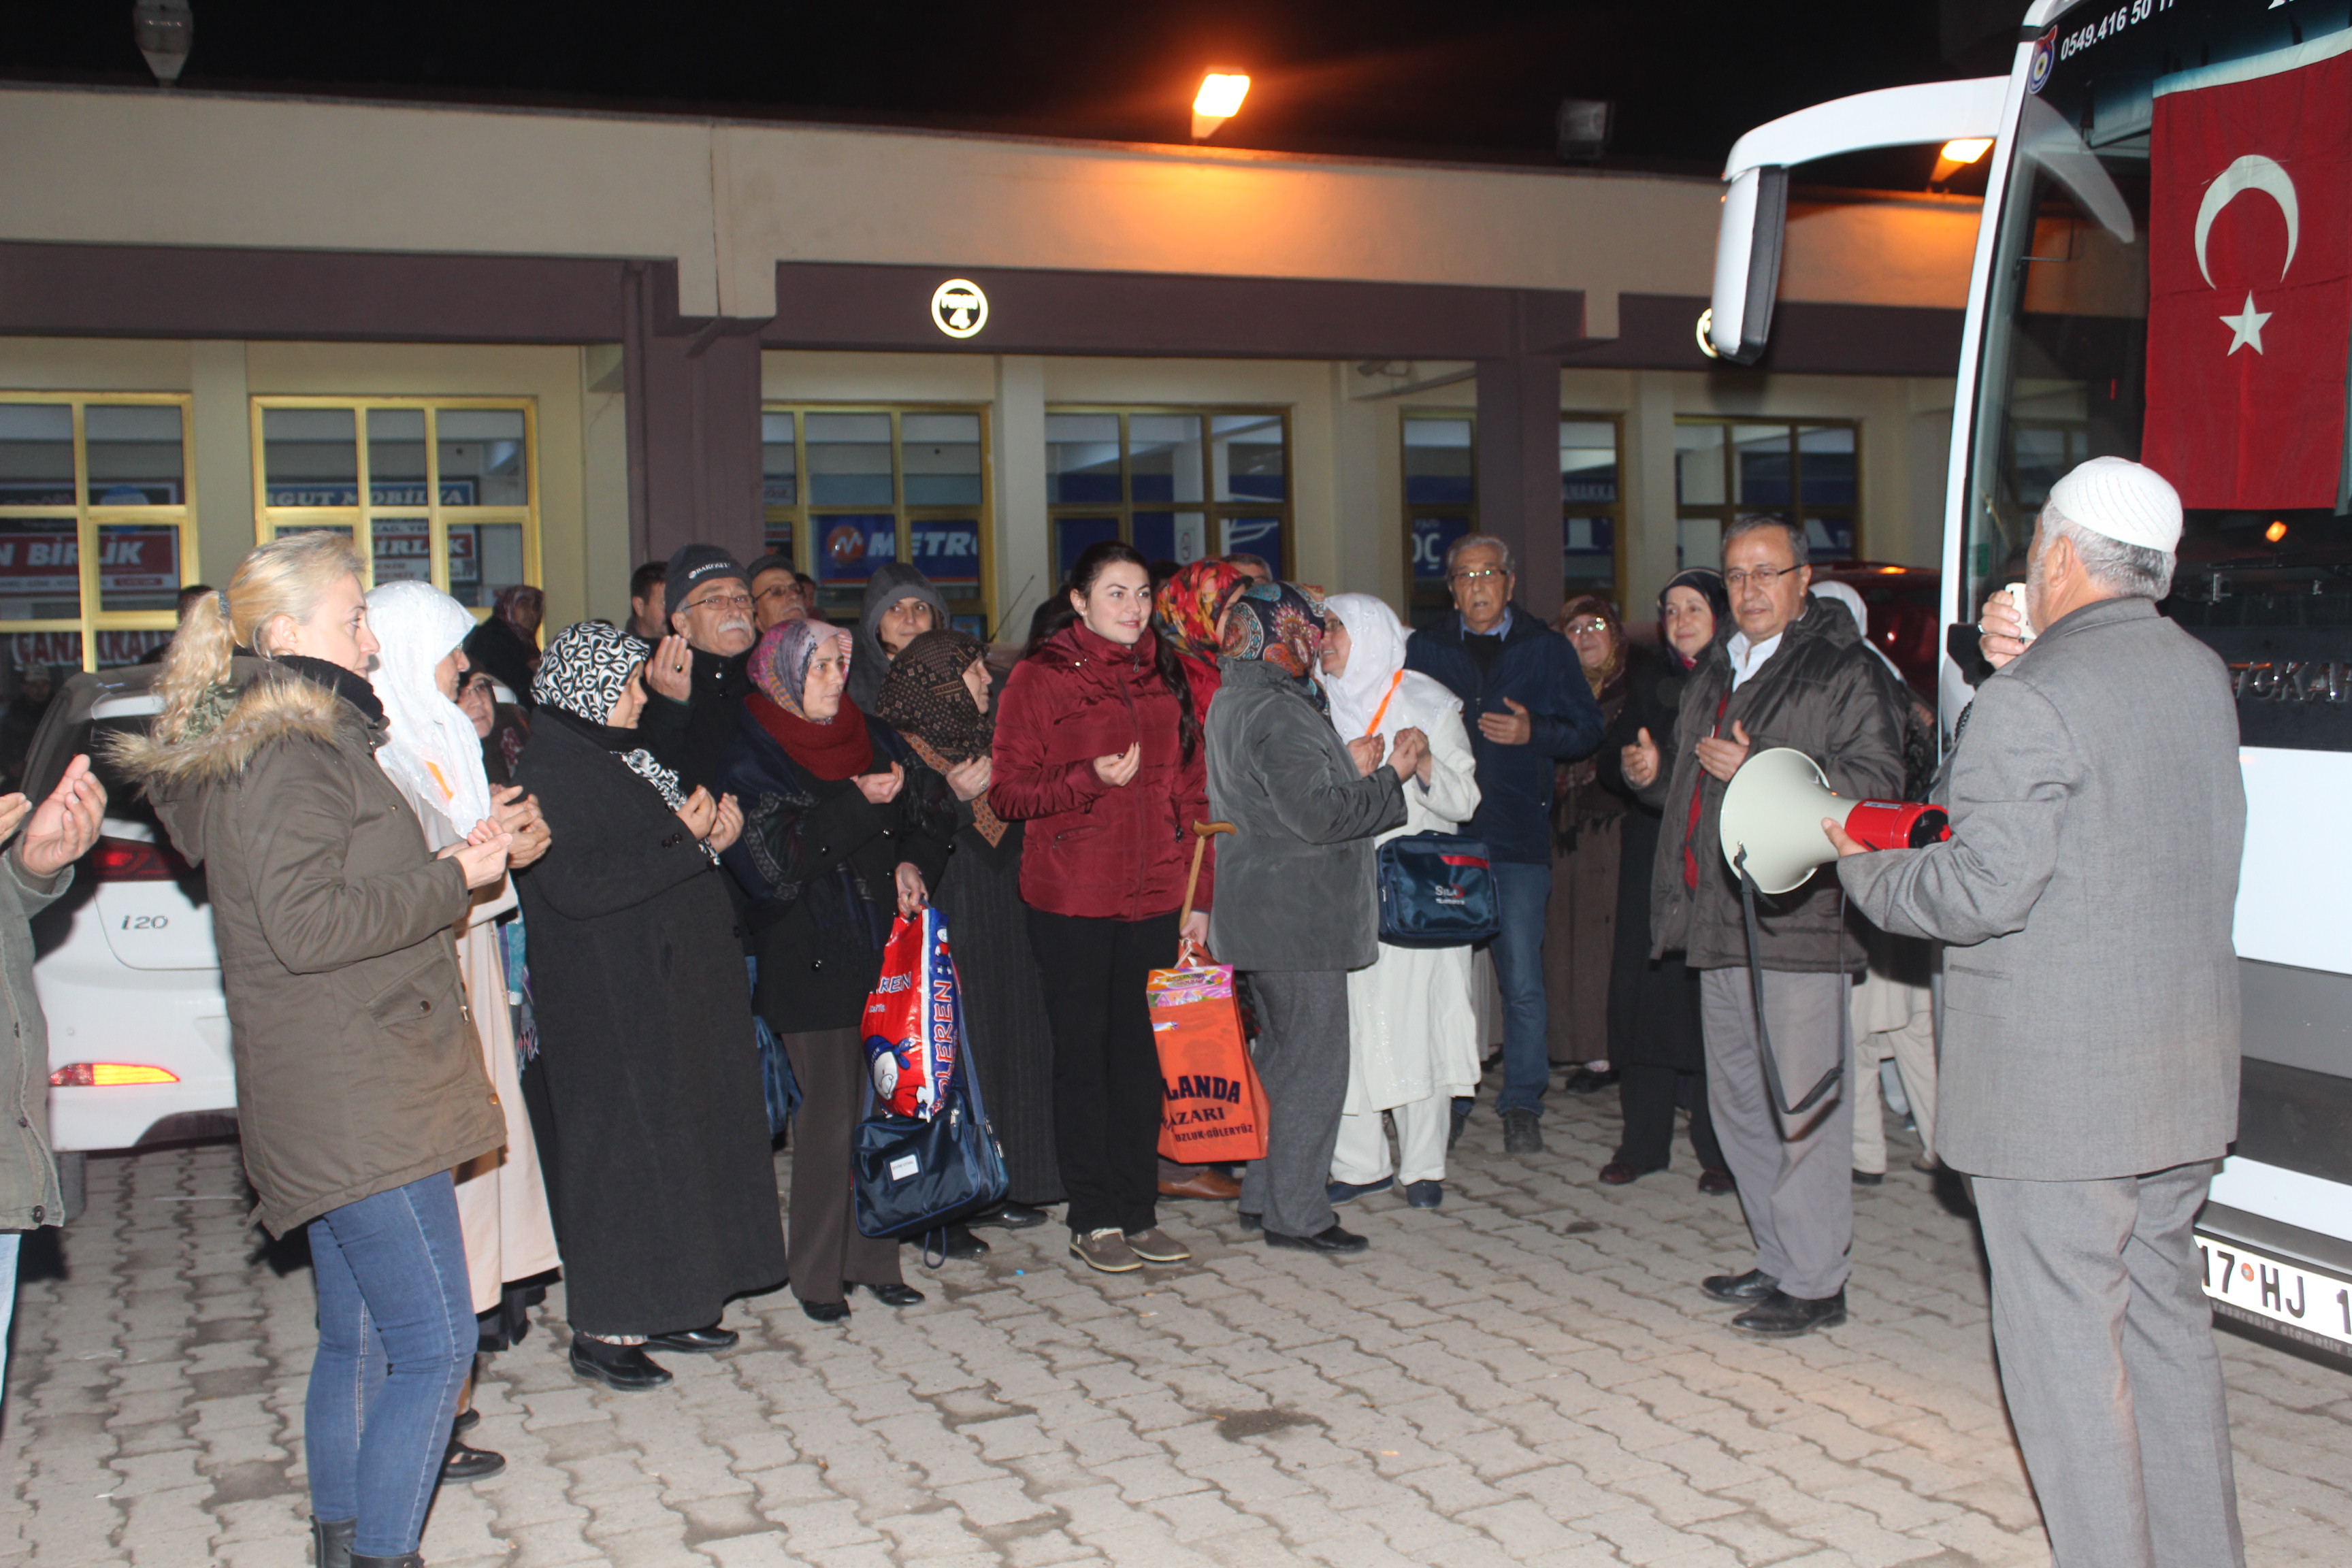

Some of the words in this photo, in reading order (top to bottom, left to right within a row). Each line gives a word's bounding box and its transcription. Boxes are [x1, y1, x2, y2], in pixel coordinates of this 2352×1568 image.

[2061, 6, 2127, 61] 0549.416
[2131, 0, 2152, 24] 50
[341, 489, 464, 506] MOBİLA
[27, 536, 145, 566] BİRİK
[374, 537, 466, 556] İRLK
[867, 532, 979, 557] METR
[121, 915, 169, 930] i20
[1162, 1107, 1226, 1131] AZARI
[2259, 1263, 2305, 1319] HJ
[2336, 1288, 2352, 1335] 1
